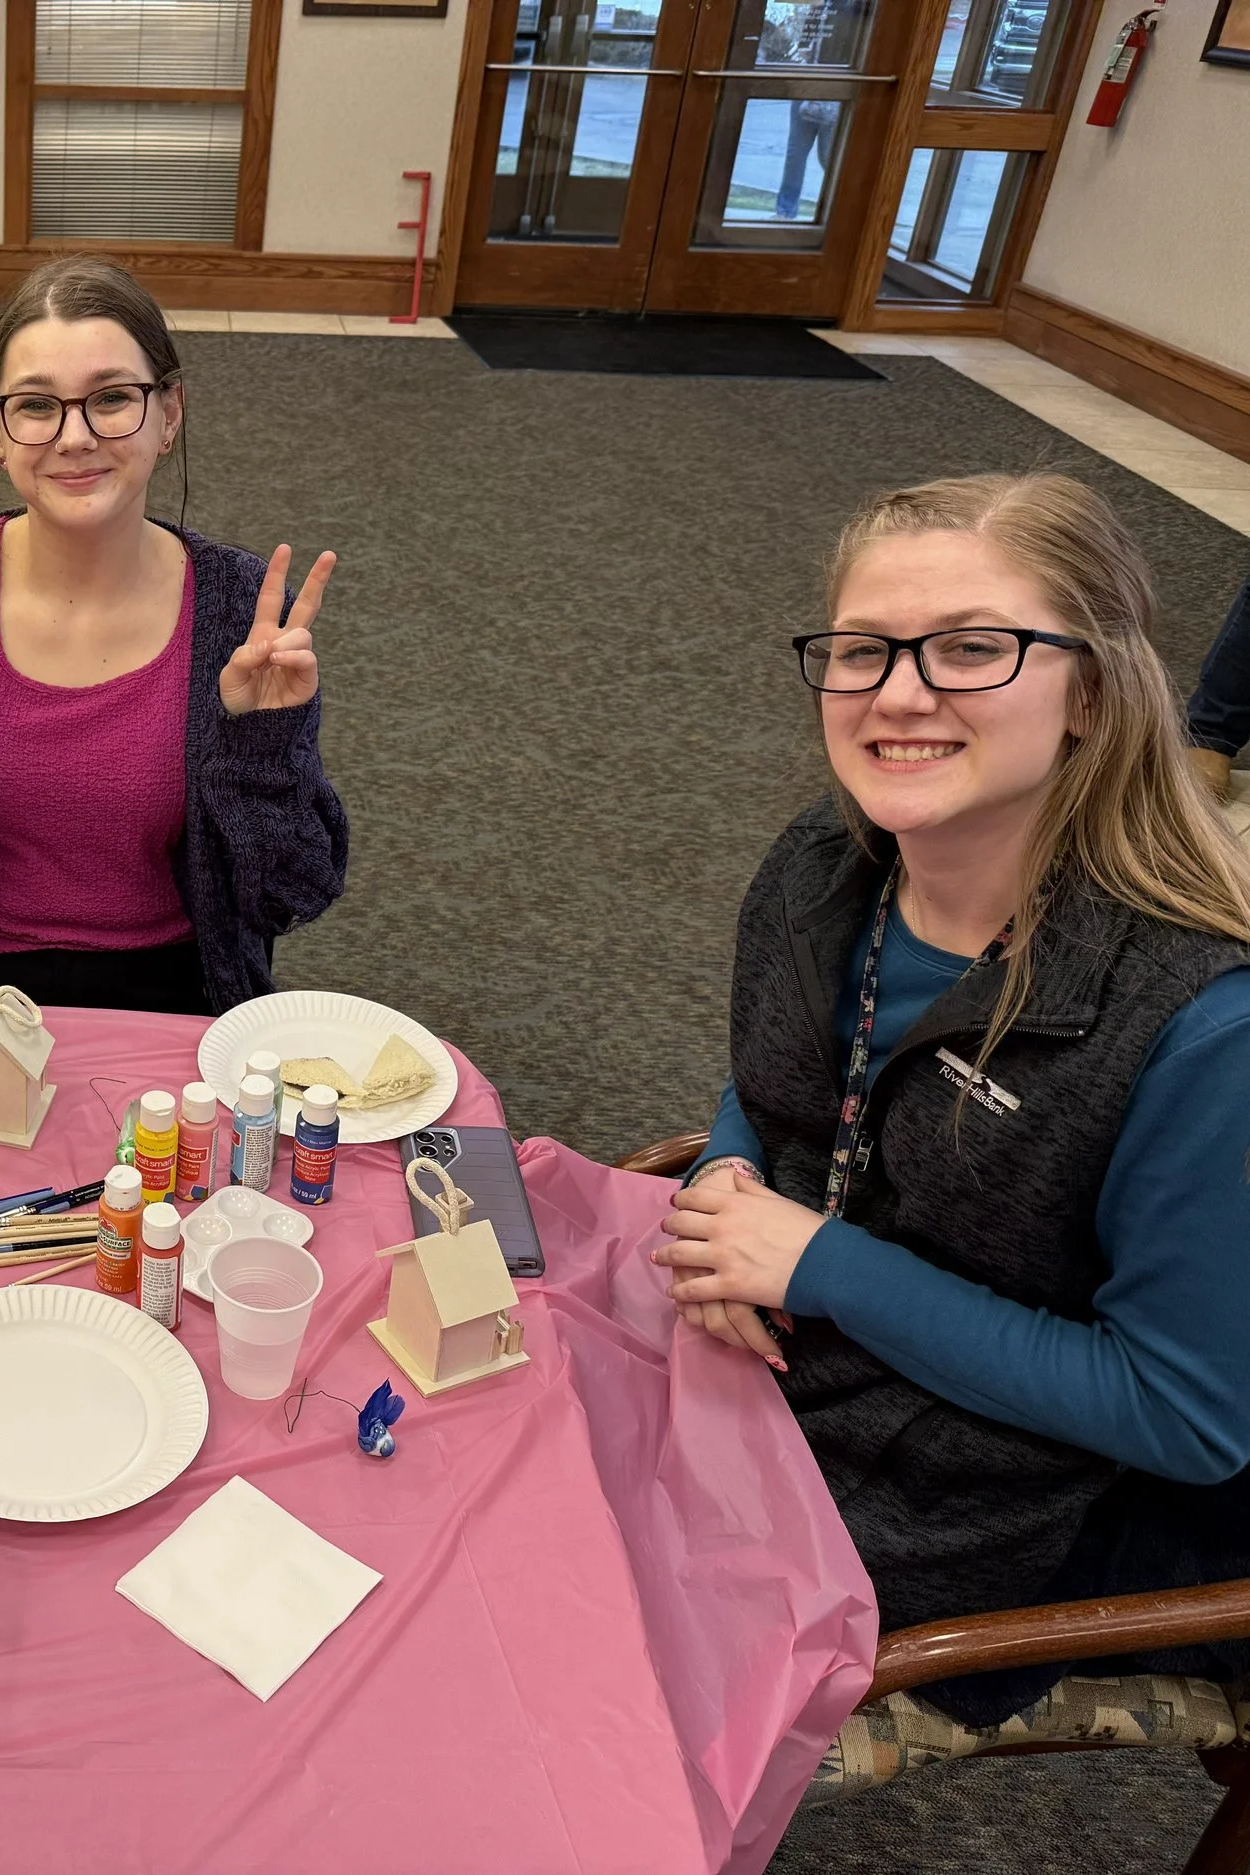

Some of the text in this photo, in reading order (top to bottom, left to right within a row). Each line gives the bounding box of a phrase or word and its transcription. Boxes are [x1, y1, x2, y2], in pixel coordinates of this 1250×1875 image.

[983, 1096, 1006, 1117] Bank
[179, 1149, 202, 1159] smart
[295, 1146, 333, 1160] craft smart
[150, 1158, 173, 1168] smart
